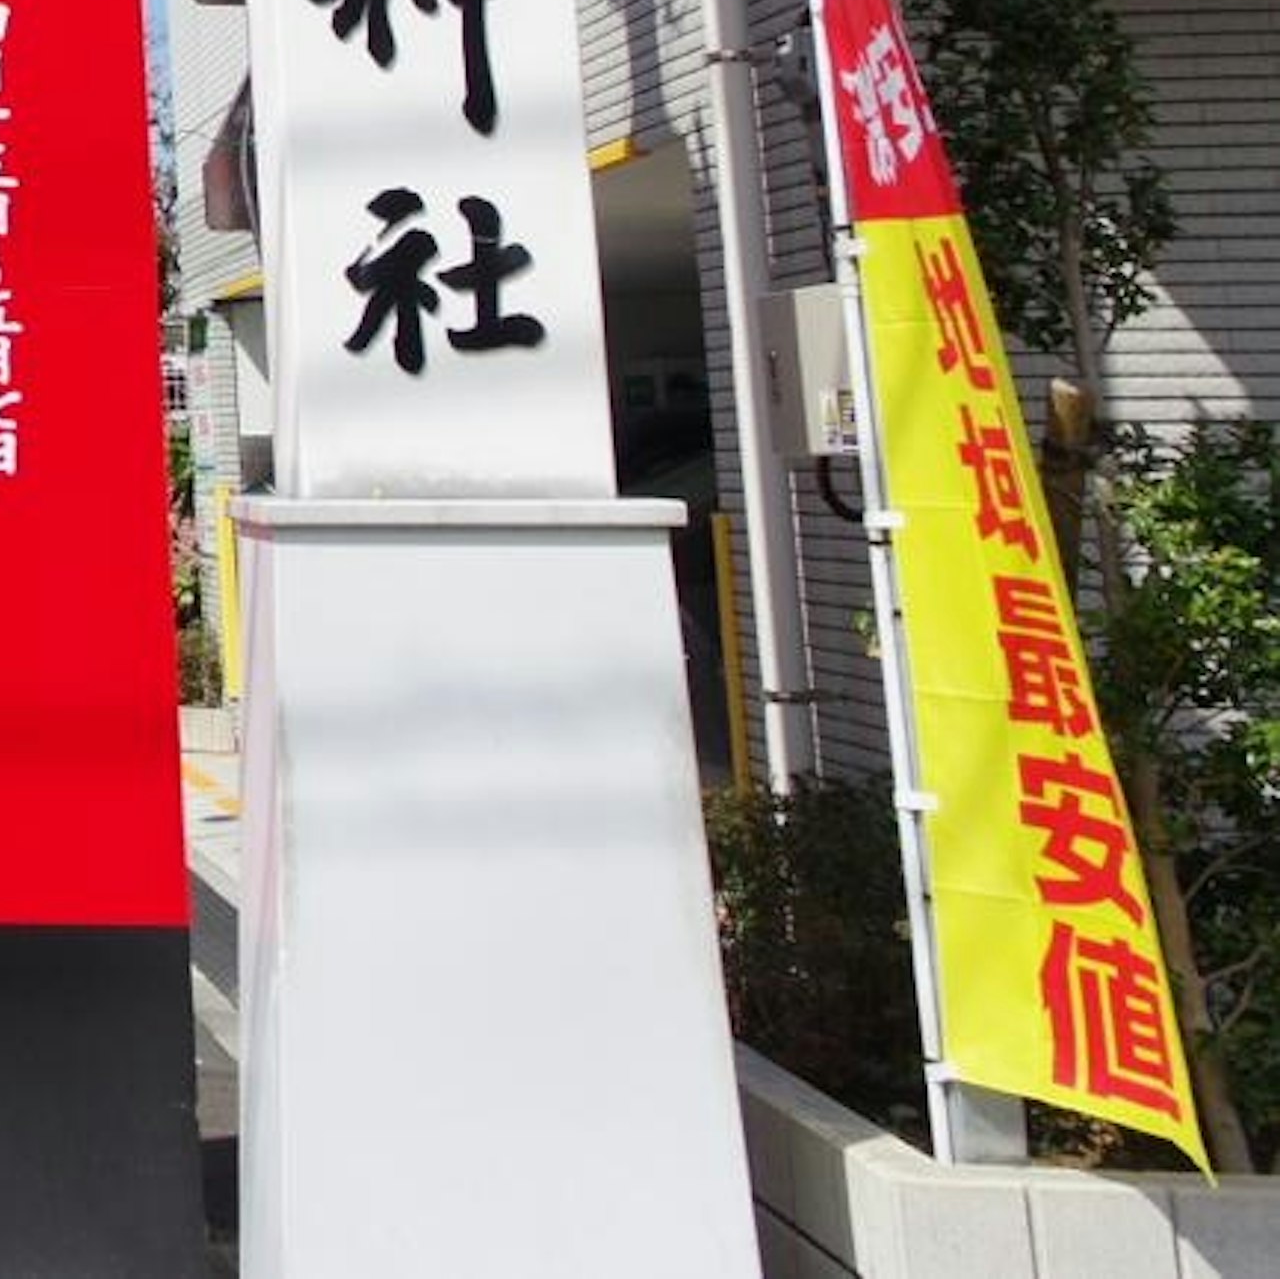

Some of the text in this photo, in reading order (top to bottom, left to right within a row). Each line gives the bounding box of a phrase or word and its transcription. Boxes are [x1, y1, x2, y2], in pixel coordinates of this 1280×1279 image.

[913, 237, 1179, 1121] 地域最安値
